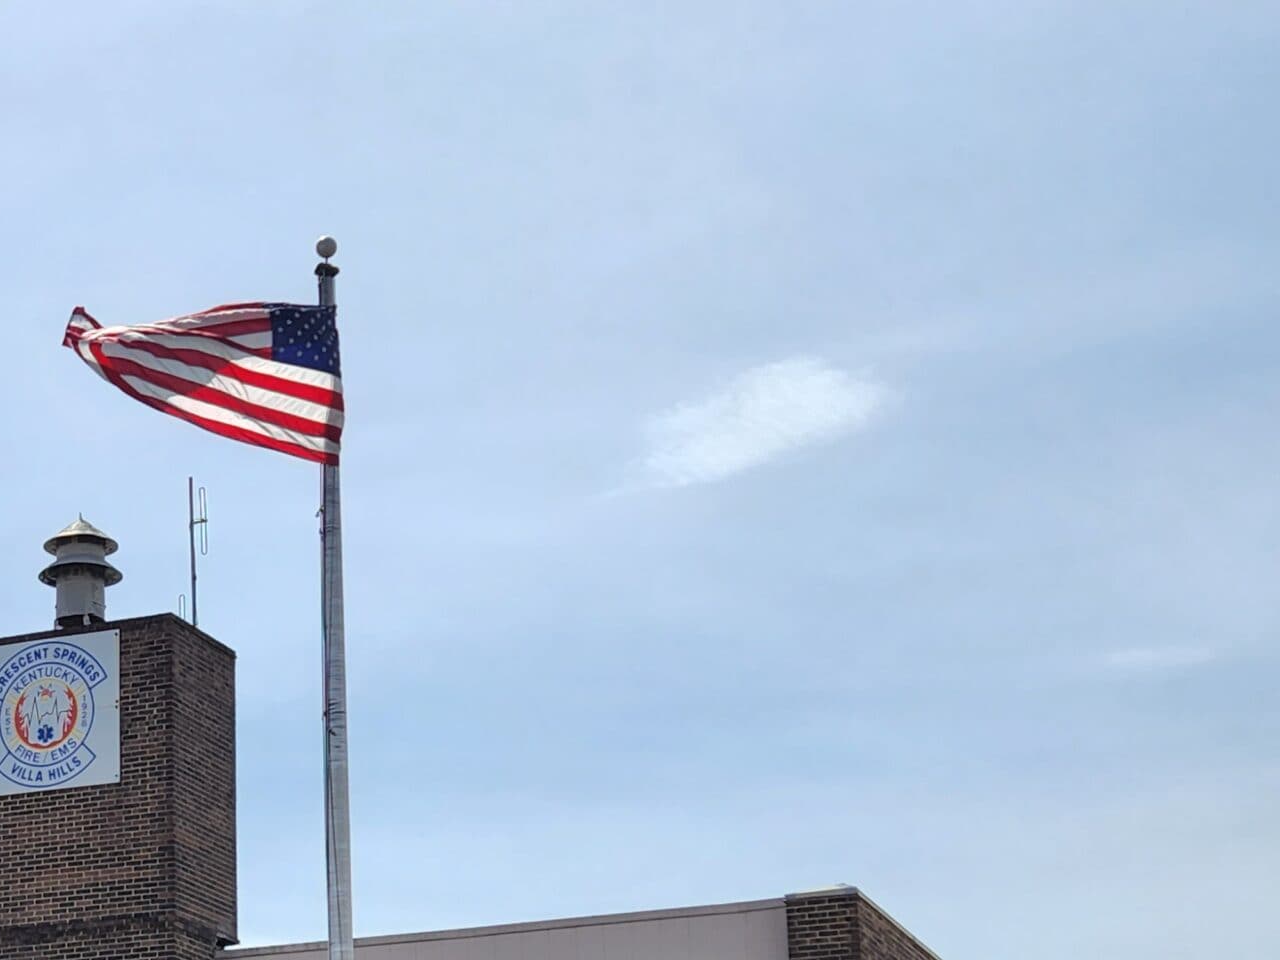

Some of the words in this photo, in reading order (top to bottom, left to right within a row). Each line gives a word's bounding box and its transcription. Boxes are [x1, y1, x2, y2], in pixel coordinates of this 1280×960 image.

[53, 647, 100, 682] SPRINGS
[13, 666, 80, 694] KENTUCKY
[11, 763, 43, 783] VILLA
[48, 756, 82, 781] HILLS
